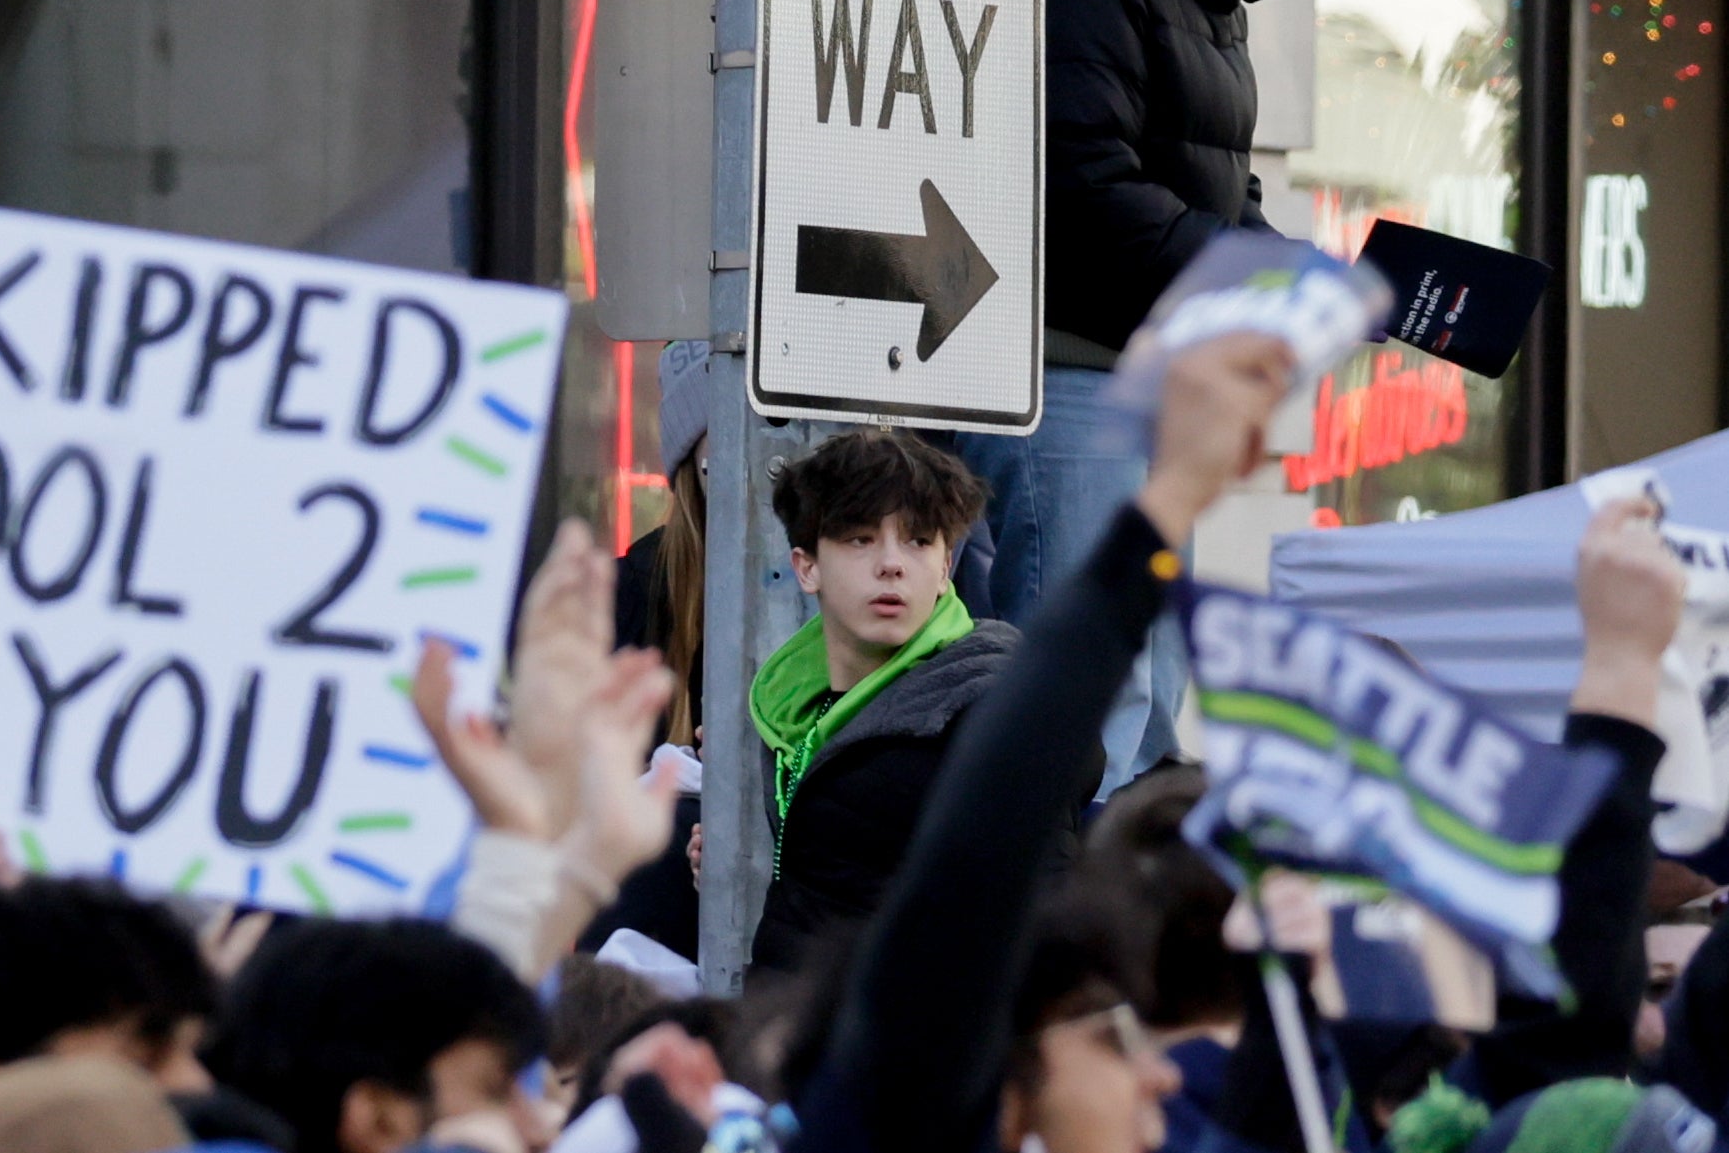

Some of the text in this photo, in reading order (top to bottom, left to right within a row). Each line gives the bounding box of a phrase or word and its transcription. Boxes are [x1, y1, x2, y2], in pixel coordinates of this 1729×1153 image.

[269, 481, 397, 655] 2
[8, 630, 342, 849] YOU
[1189, 593, 1525, 831] SEATTLE
